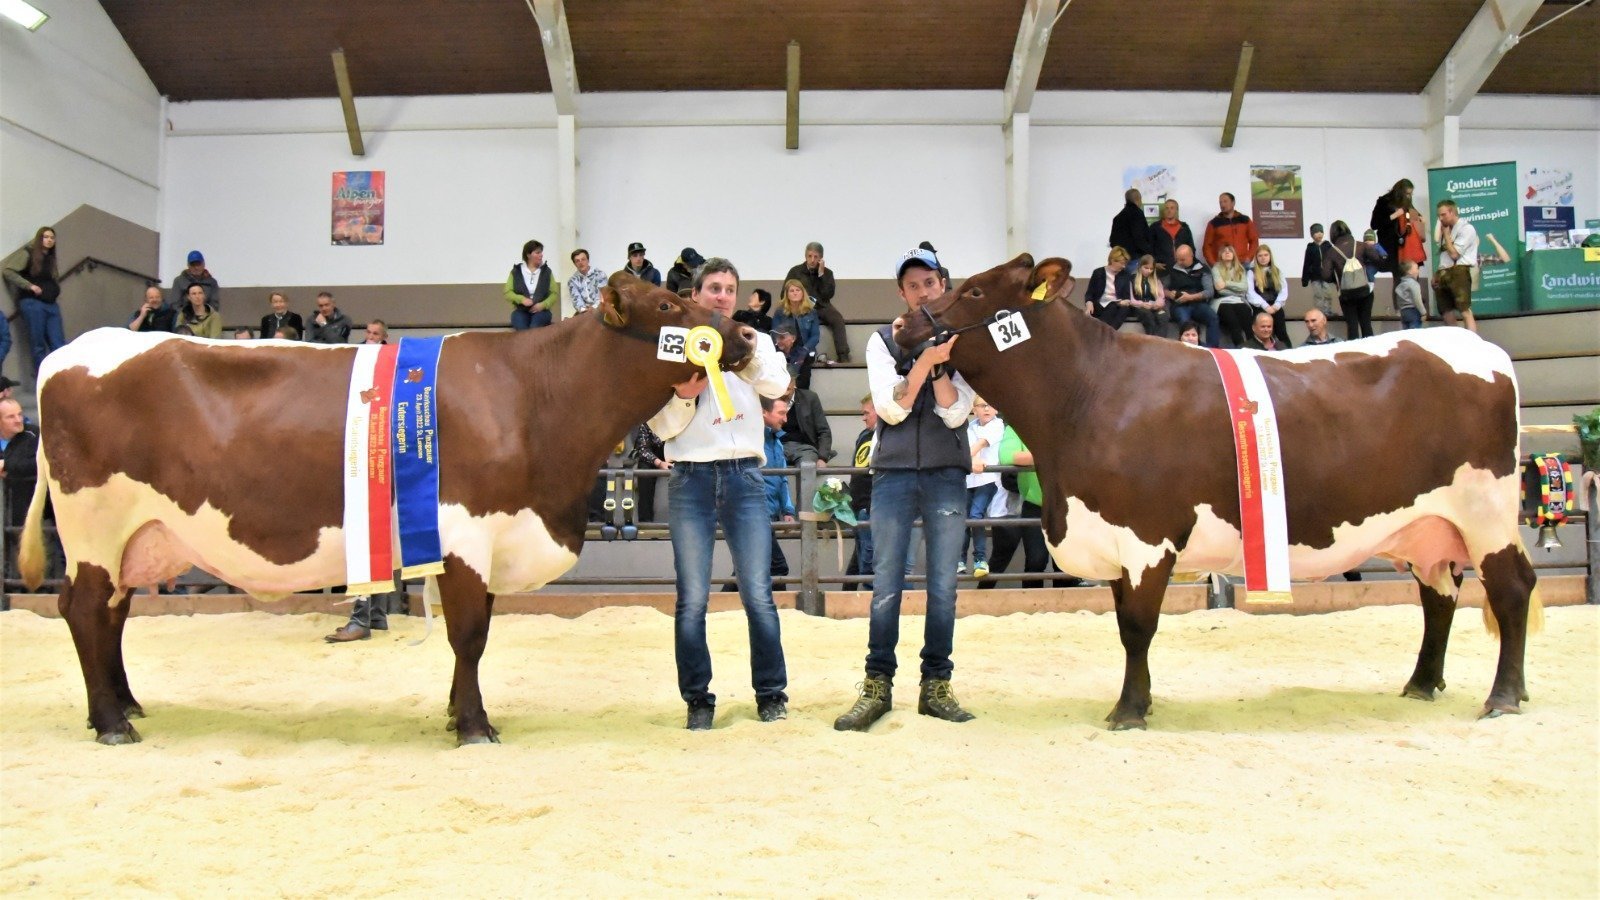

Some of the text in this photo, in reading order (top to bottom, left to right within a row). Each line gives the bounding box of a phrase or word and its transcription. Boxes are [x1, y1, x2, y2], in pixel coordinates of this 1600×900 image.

[336, 186, 376, 200] Alpen
[1446, 177, 1498, 193] Landwirt
[1463, 209, 1509, 222] winnspiel
[1541, 272, 1600, 290] Landwir
[998, 320, 1021, 344] 34
[663, 334, 684, 354] 53
[397, 402, 408, 453] Eutersiegerin
[425, 430, 433, 464] Pinzgauer
[378, 449, 387, 484] Pinzgauer
